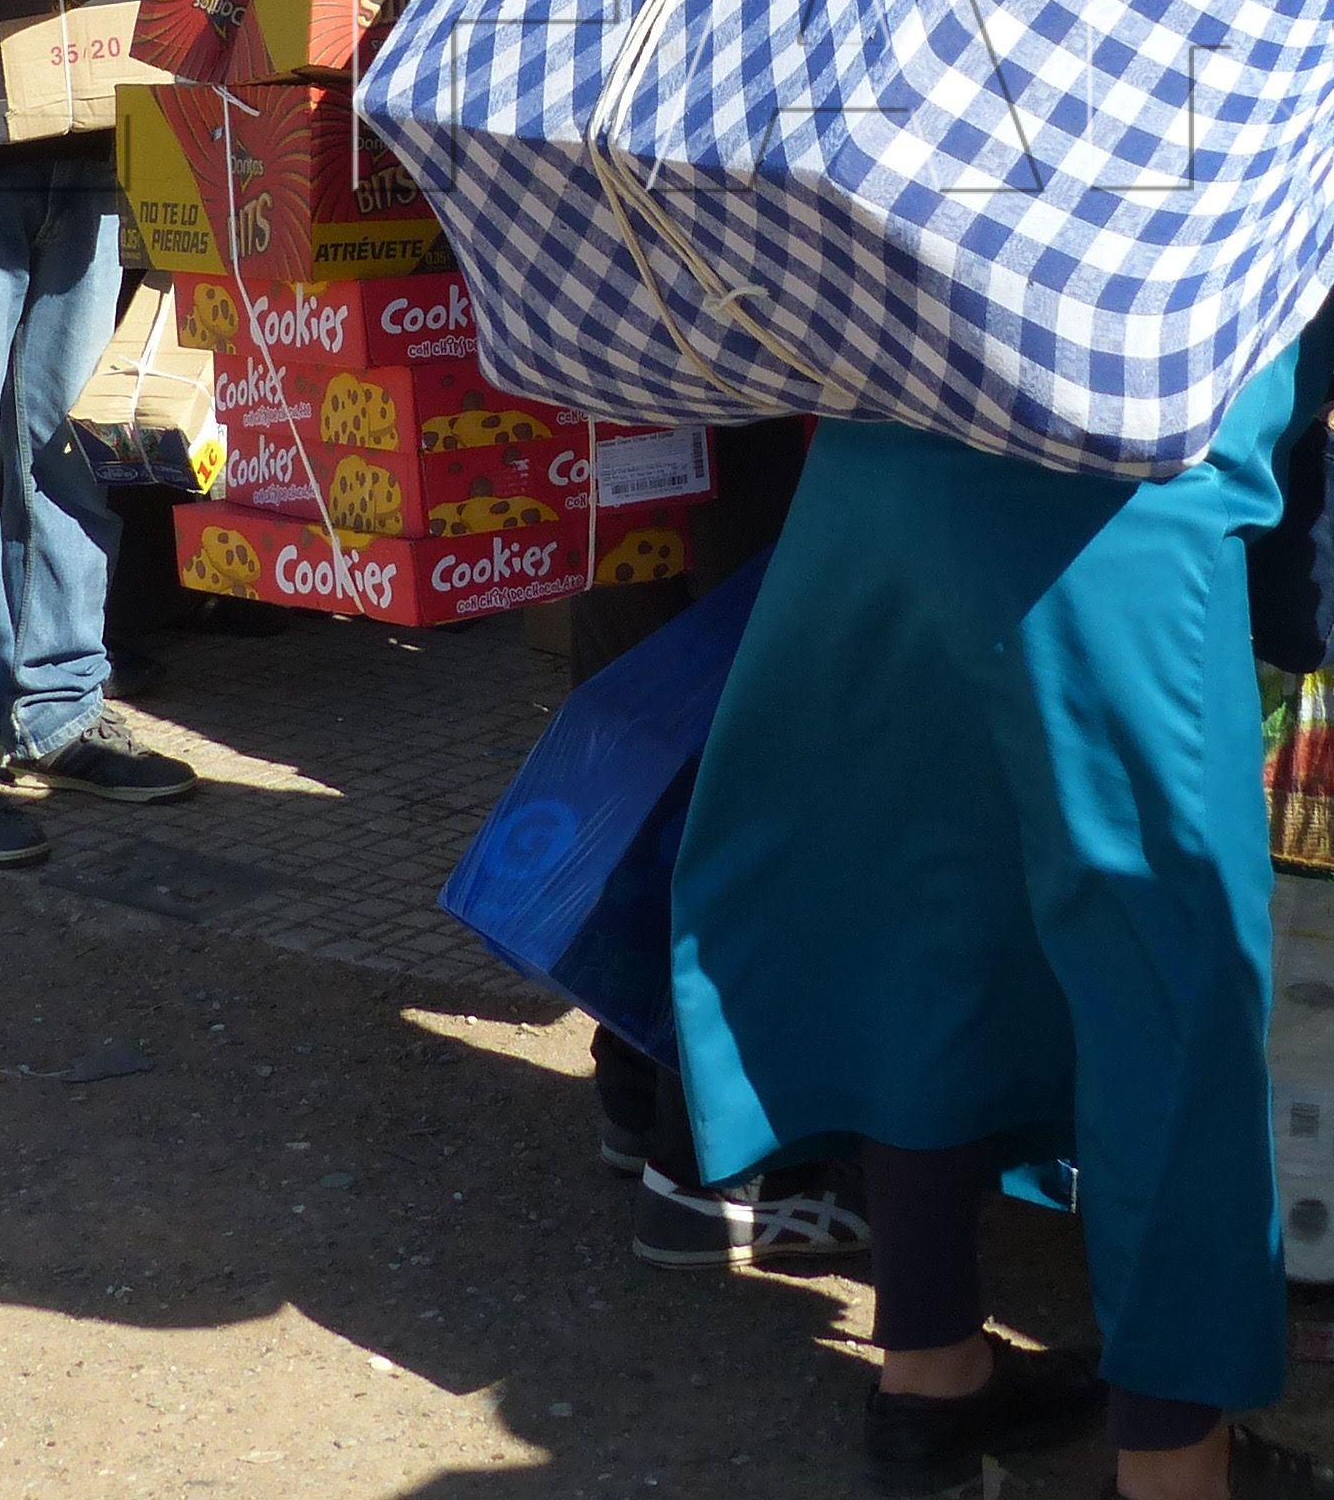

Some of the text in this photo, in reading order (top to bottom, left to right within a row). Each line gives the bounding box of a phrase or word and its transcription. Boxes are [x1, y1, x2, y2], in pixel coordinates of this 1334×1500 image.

[139, 201, 199, 226] NO TE LO
[357, 165, 419, 214] BITS
[151, 228, 210, 255] PIERDAS
[315, 236, 425, 262] ATRÉVETE
[250, 282, 475, 353] Cookies Cook
[215, 357, 286, 412] Cookies
[228, 435, 297, 487] Cookies
[275, 537, 558, 609] Cookies Cookies
